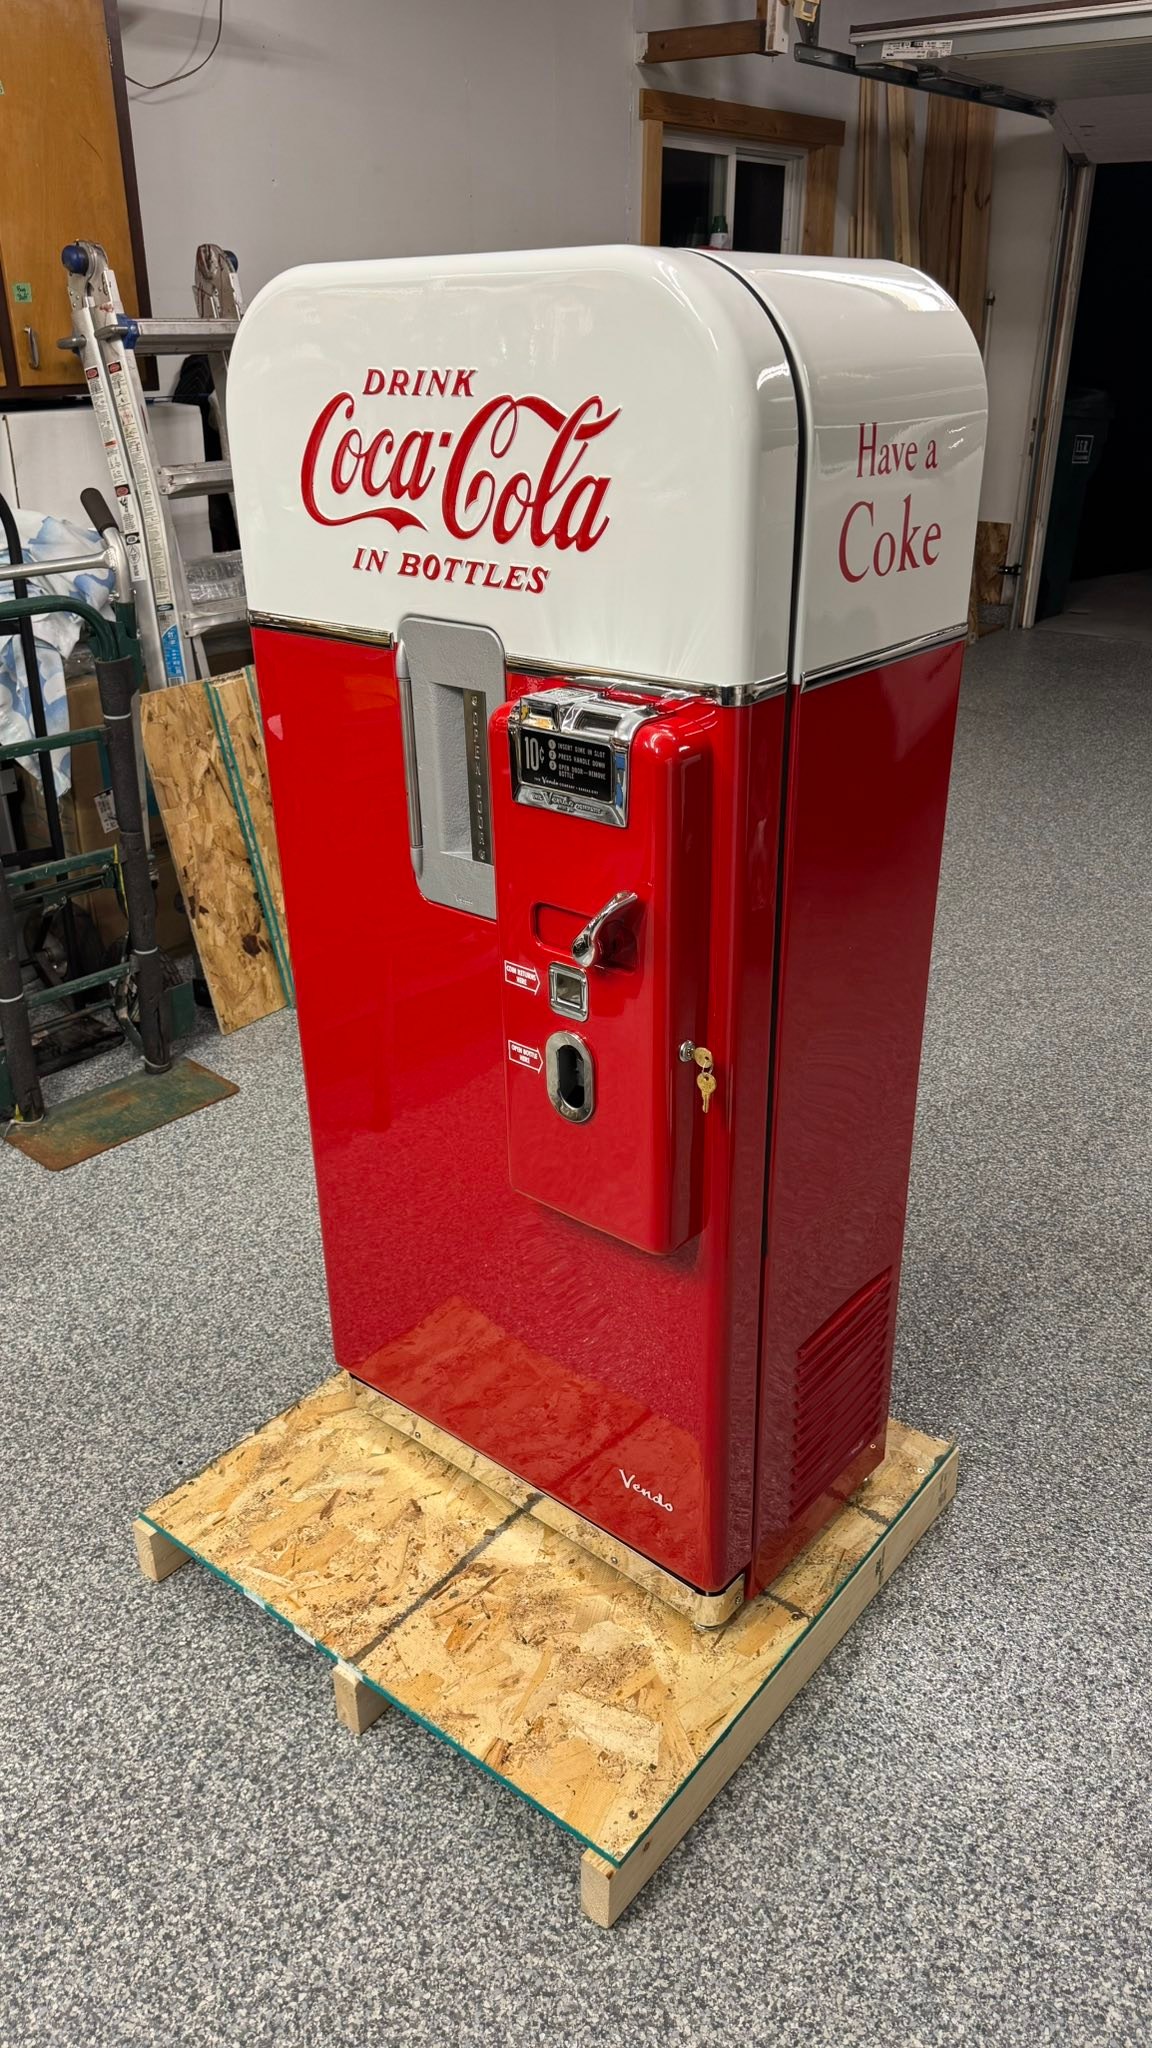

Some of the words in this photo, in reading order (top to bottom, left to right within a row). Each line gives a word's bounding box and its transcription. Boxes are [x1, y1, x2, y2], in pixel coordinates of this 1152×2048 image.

[362, 368, 479, 397] DRINK
[856, 422, 918, 478] Have
[925, 439, 938, 469] a
[301, 391, 622, 553] Coca-Cola
[839, 493, 942, 583] Coke
[352, 547, 389, 573] IN
[398, 552, 551, 595] BOTTLES
[557, 743, 573, 751] INSERT
[574, 745, 586, 755] DIME
[587, 748, 593, 756] IN
[594, 750, 606, 759] SLOT
[558, 753, 572, 762] PRESS
[573, 756, 591, 766] HANDLE
[592, 760, 606, 769] DOWN
[558, 763, 570, 772] OPEN
[541, 776, 559, 785] Vendo
[558, 771, 575, 779] BOTTLE
[506, 965, 517, 974] COIN
[516, 976, 527, 985] HERE
[511, 1044, 523, 1054] OPEN
[523, 1048, 538, 1060] BOTTLE
[519, 1055, 530, 1064] HERE
[618, 1468, 674, 1512] Vendo
